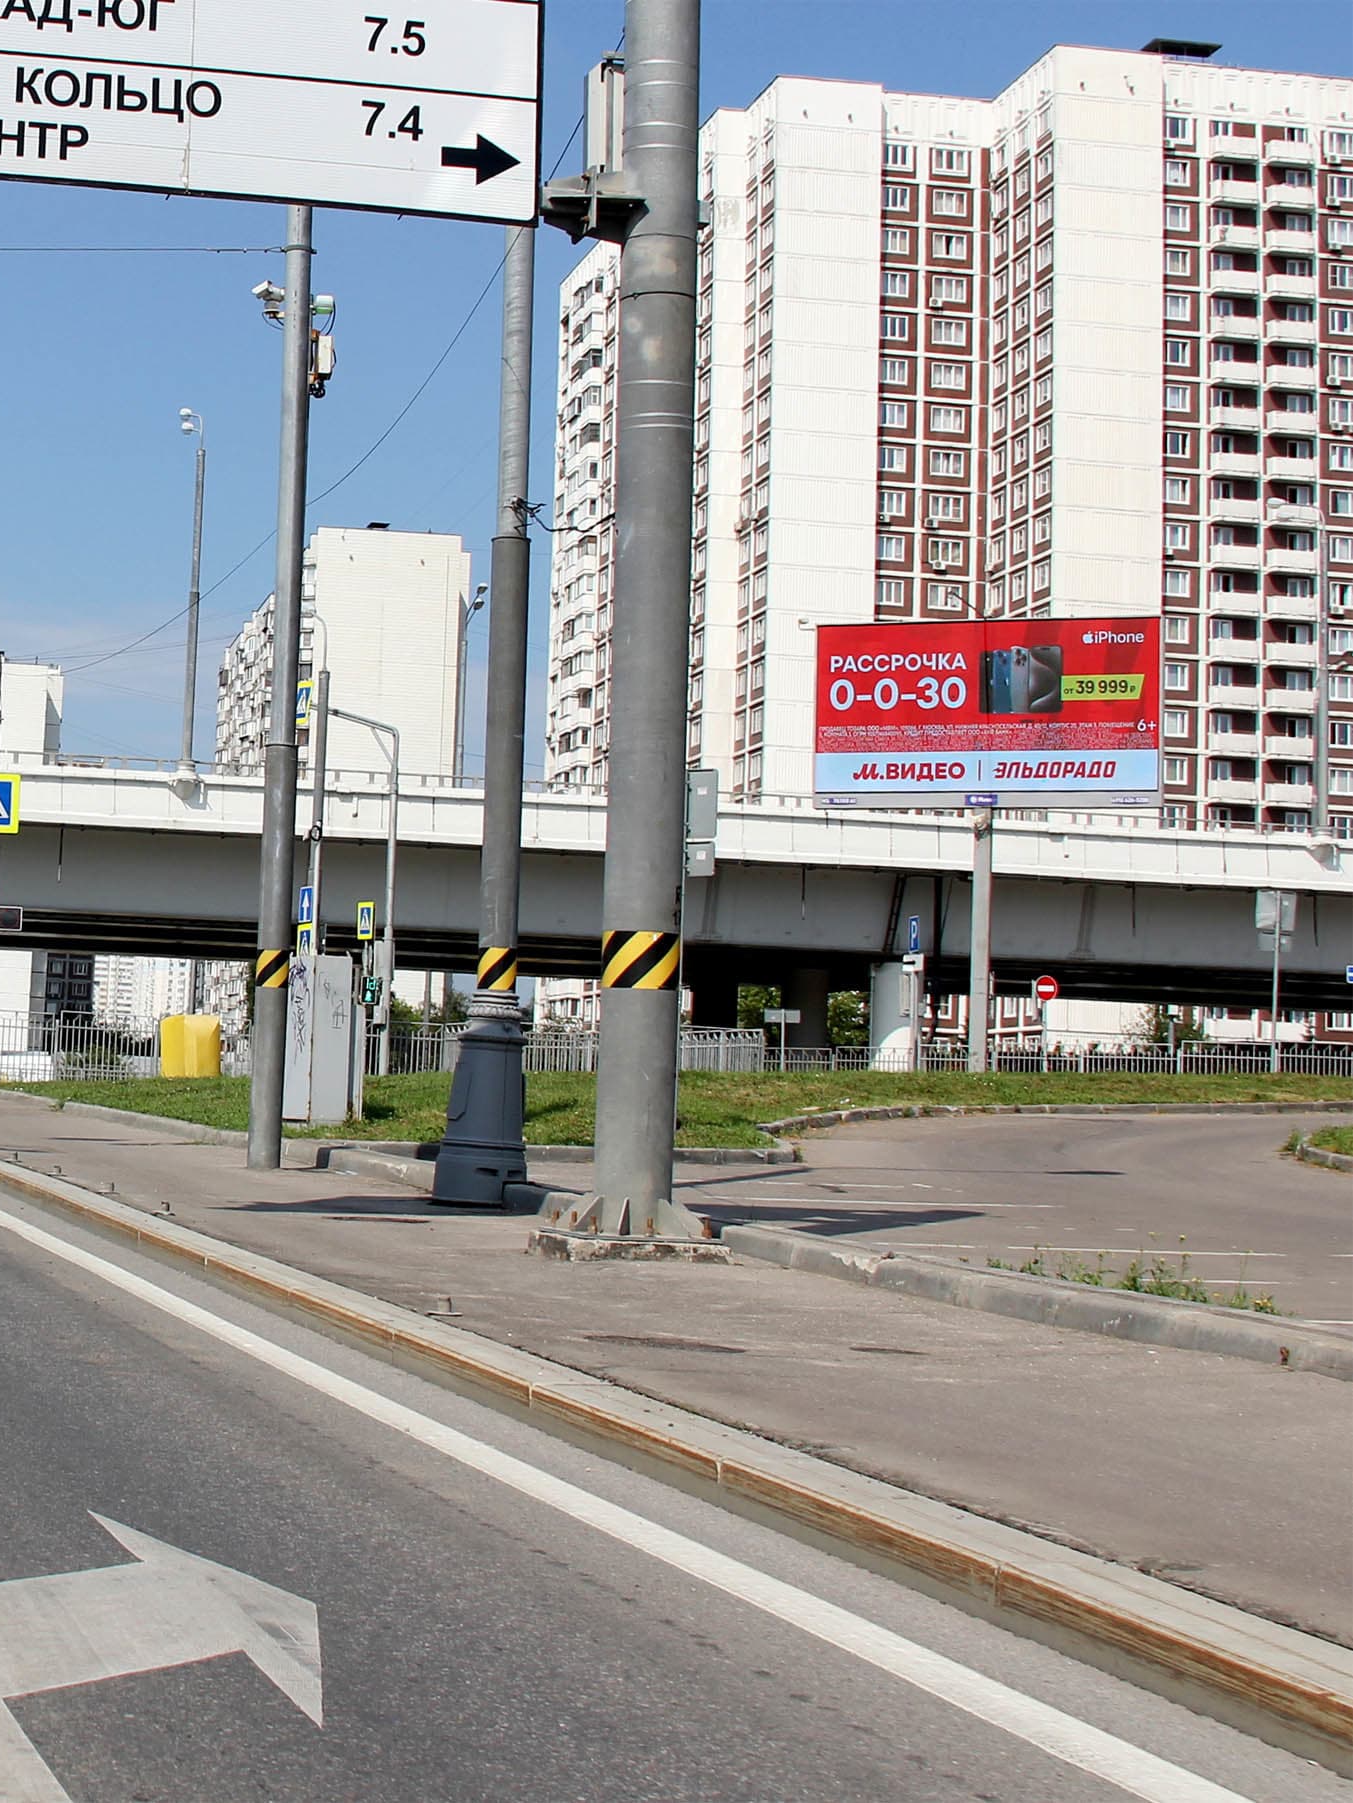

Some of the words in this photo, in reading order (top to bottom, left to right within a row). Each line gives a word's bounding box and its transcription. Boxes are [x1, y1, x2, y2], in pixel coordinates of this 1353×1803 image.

[364, 16, 426, 57] 7.5
[15, 66, 223, 123] КОЛЬЦО
[361, 100, 423, 141] 7.4
[1094, 630, 1145, 644] iPhone
[830, 652, 967, 673] РАССРОЧКА
[829, 676, 967, 711] 0-0-30
[1075, 680, 1095, 694] 39
[1098, 679, 1128, 693] 999
[1137, 718, 1157, 732] 6+
[994, 761, 1117, 779] ЭЛЬДОРАДО
[911, 920, 918, 949] P
